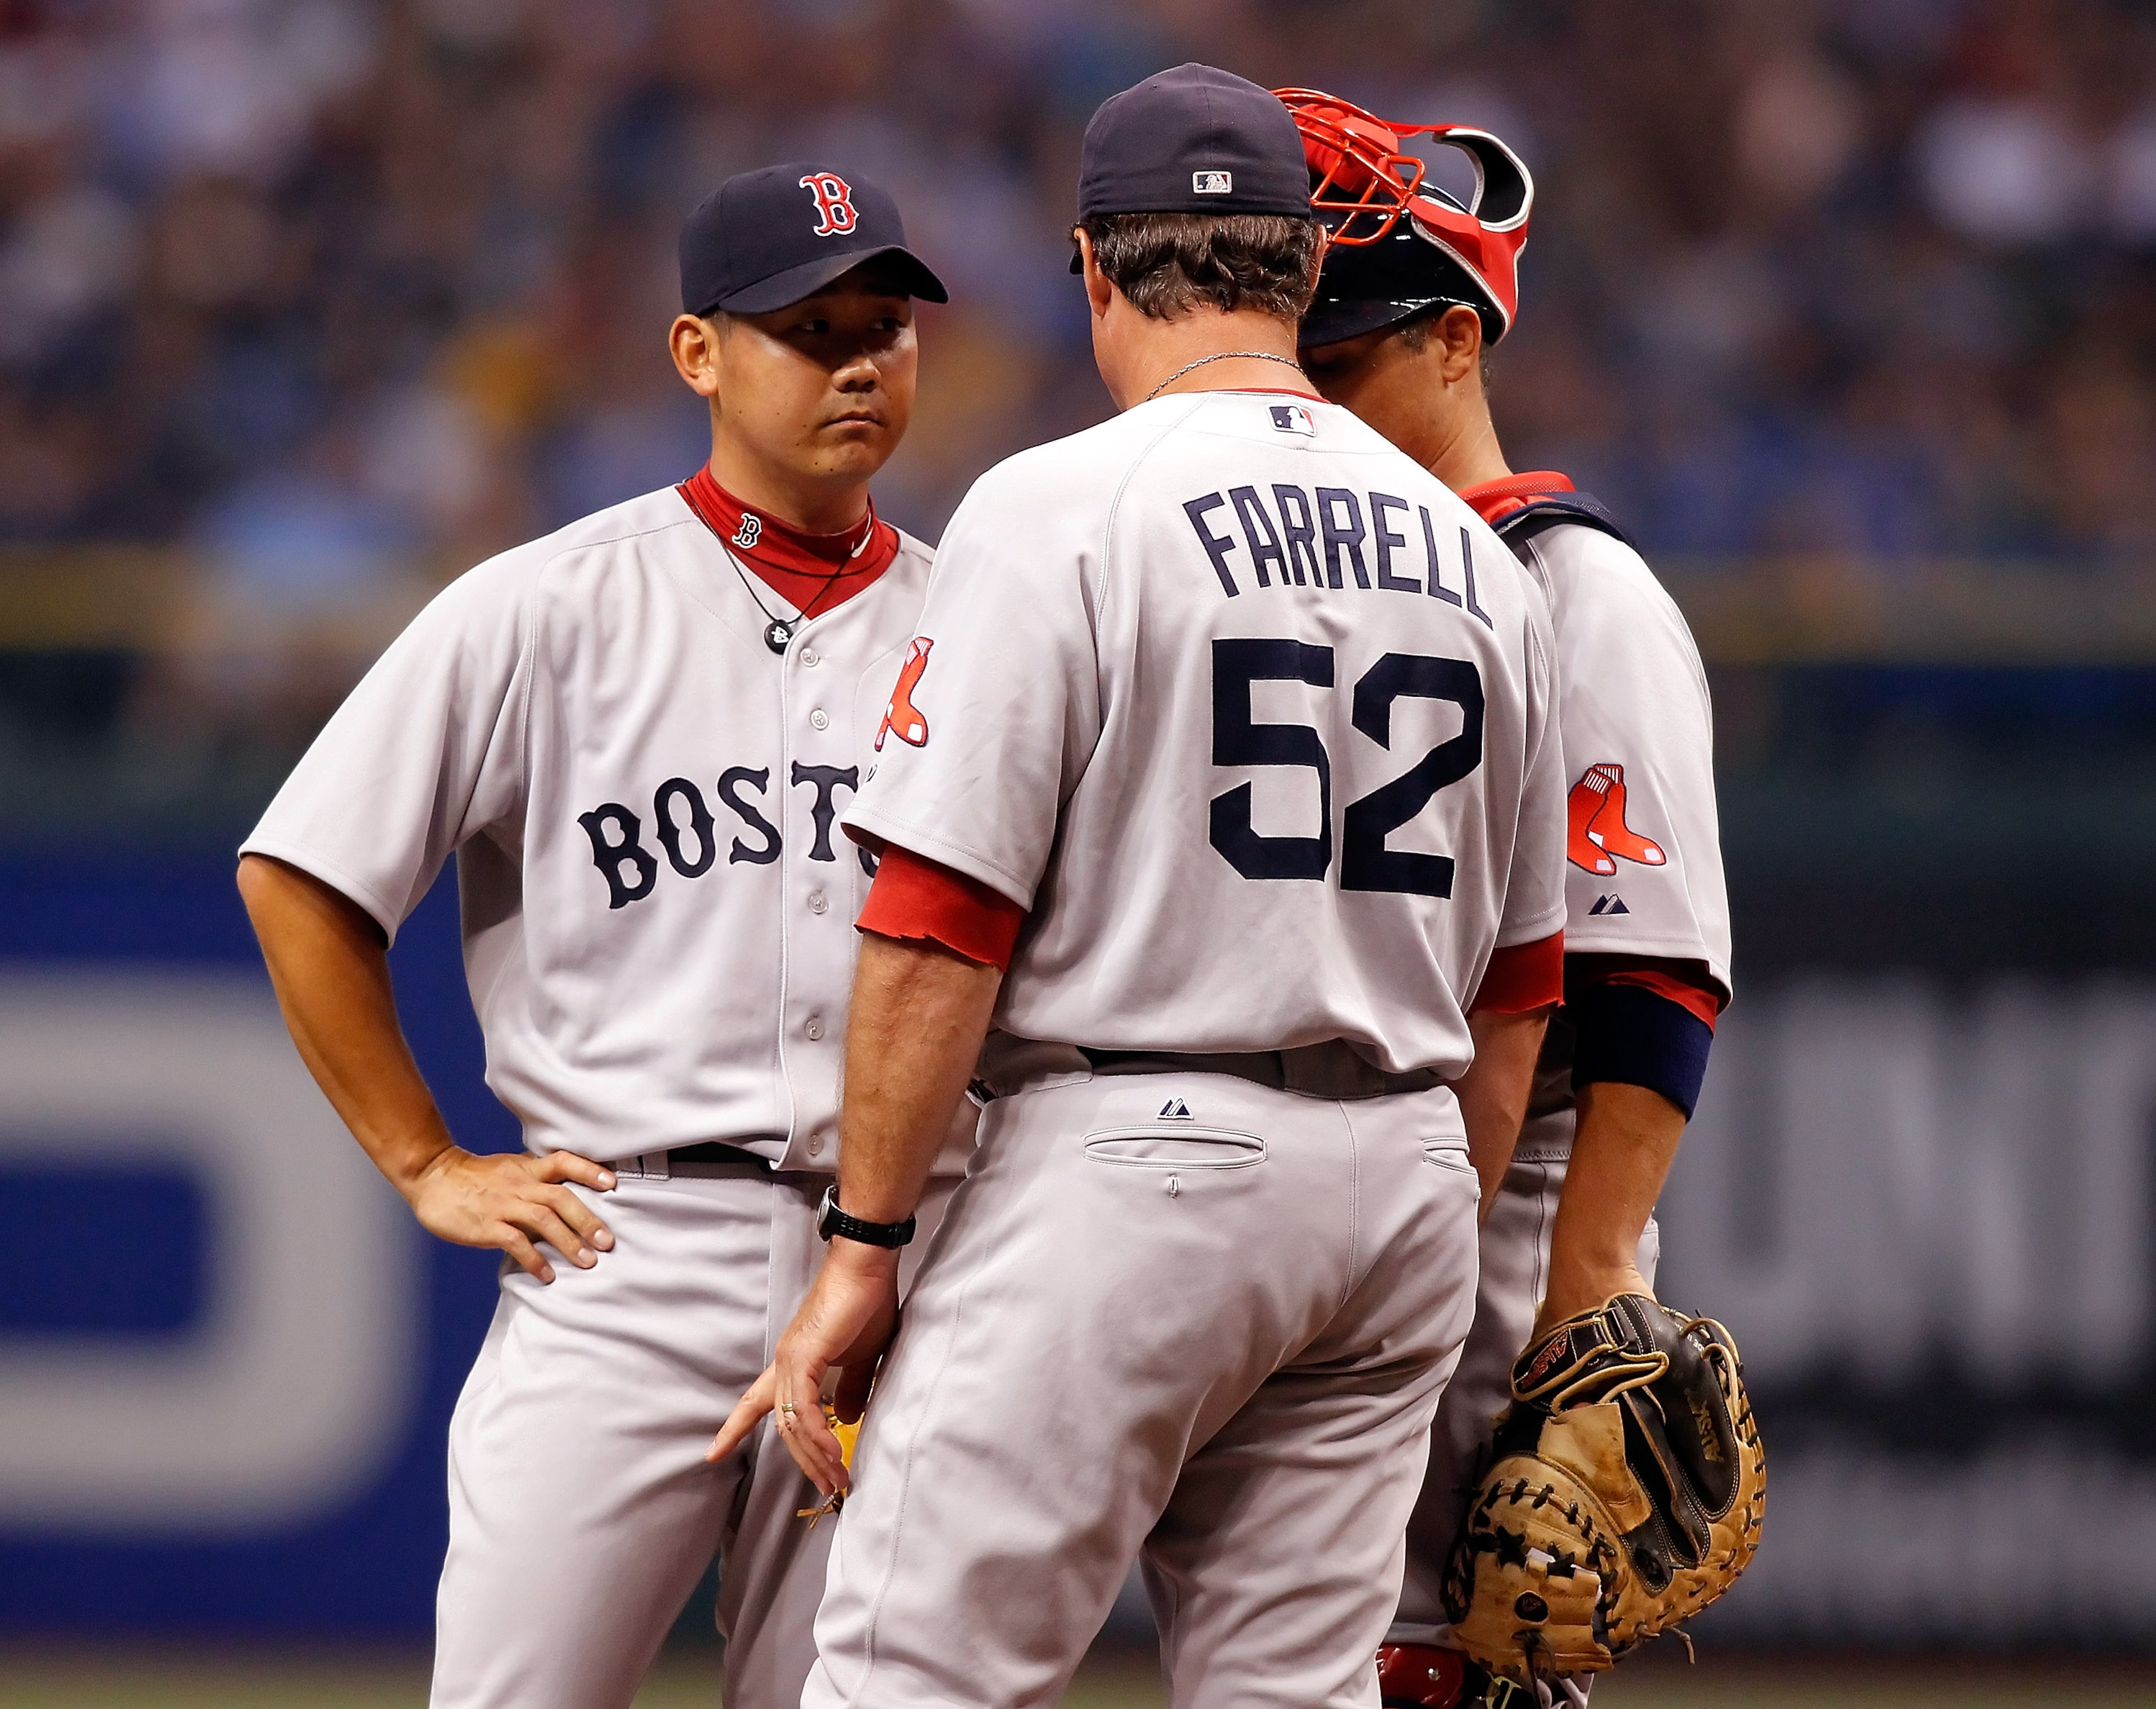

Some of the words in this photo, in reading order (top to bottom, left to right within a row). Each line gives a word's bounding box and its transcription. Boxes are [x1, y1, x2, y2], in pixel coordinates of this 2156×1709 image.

[798, 172, 860, 237] B
[731, 512, 763, 549] B
[1182, 483, 1493, 630] FARRELL
[577, 760, 877, 910] BOST
[1209, 638, 1485, 899] 52
